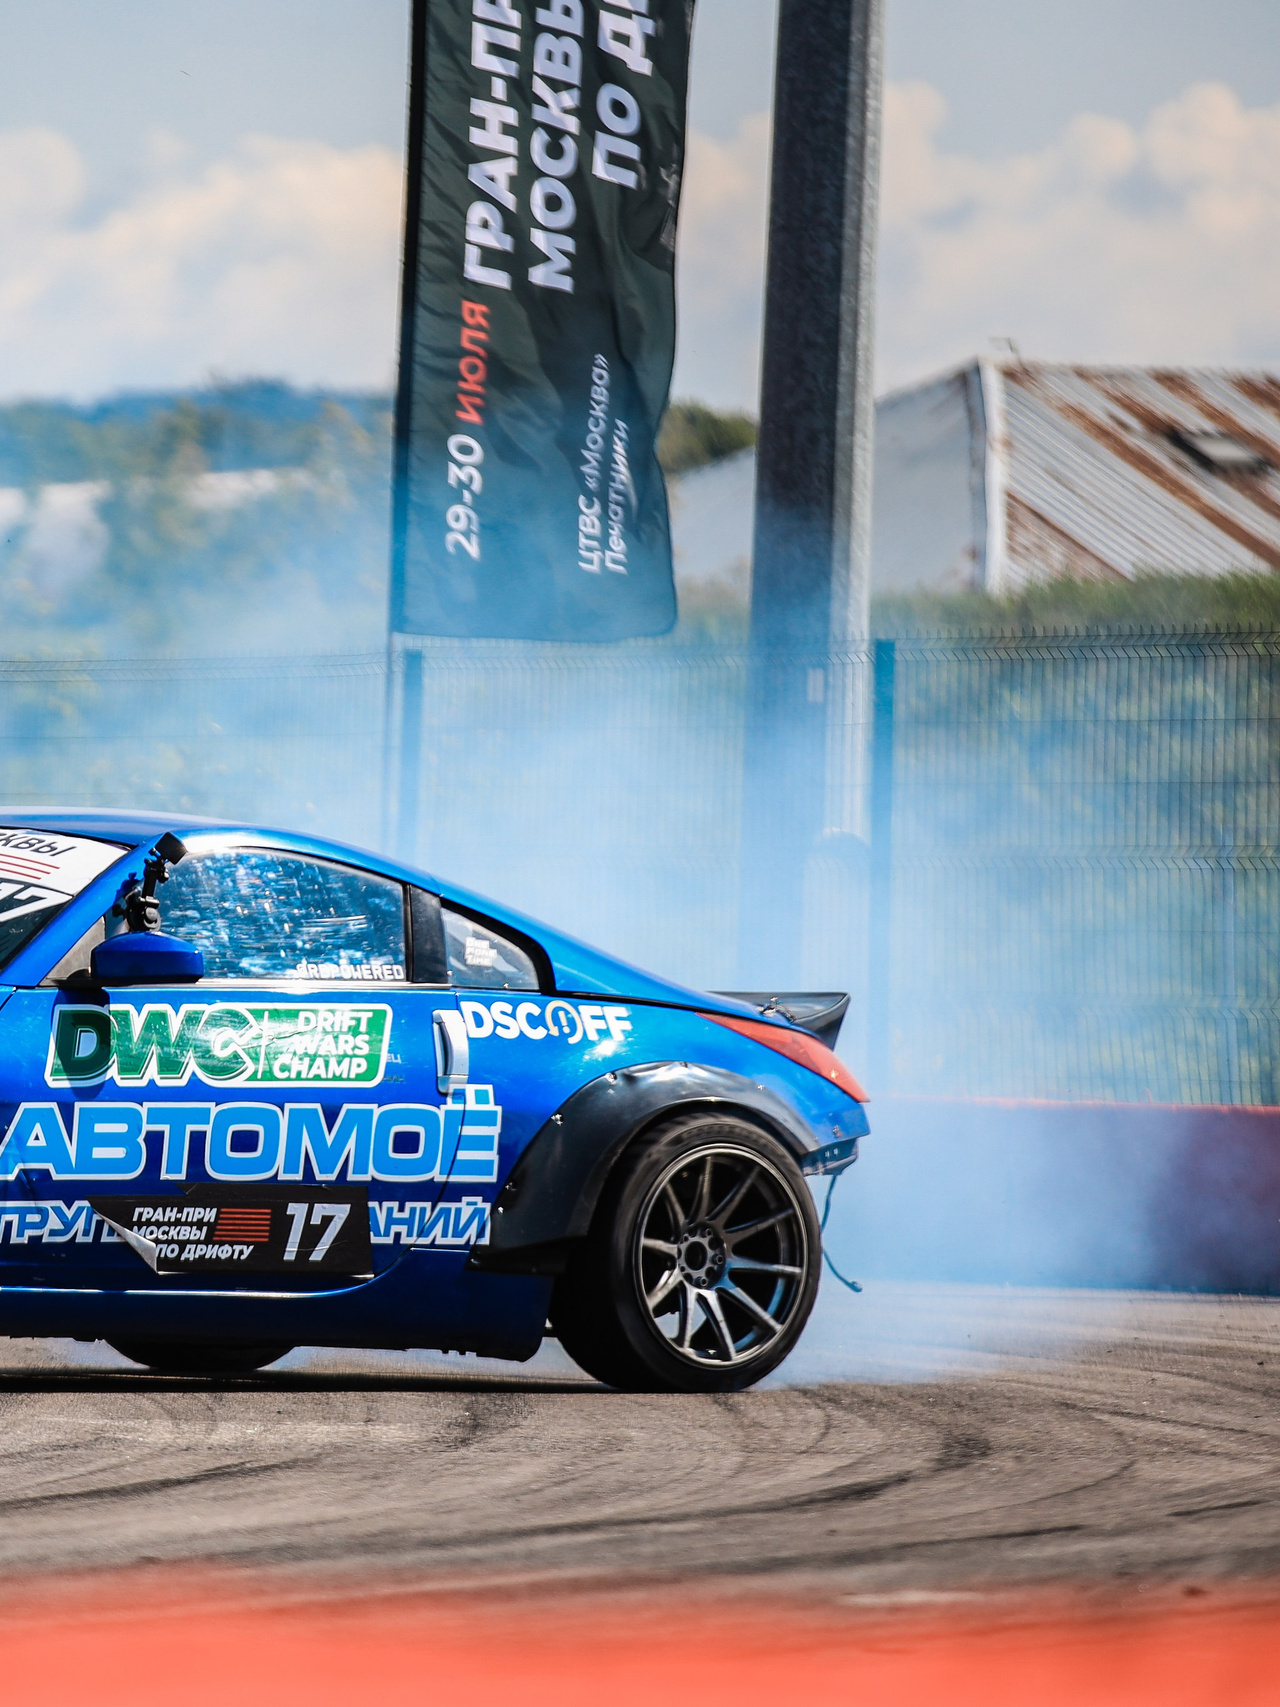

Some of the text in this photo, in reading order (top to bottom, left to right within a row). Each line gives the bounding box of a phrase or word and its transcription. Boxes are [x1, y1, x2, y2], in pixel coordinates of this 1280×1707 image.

[592, 82, 641, 190] ПО
[444, 300, 491, 561] 29-30 ИЮЛЯ
[578, 353, 611, 574] ЦТВС «Москва»
[604, 418, 630, 575] Печатники
[297, 1011, 373, 1033] DRIFT
[47, 1003, 261, 1086] DWC
[290, 1034, 370, 1055] WARS
[273, 1056, 368, 1079] CHAMP
[132, 1207, 218, 1222] ГРАН-ПРИ
[132, 1225, 208, 1241] МОСКВЫ
[283, 1202, 352, 1261] 17
[155, 1243, 255, 1261] ПО ДРИФТУ
